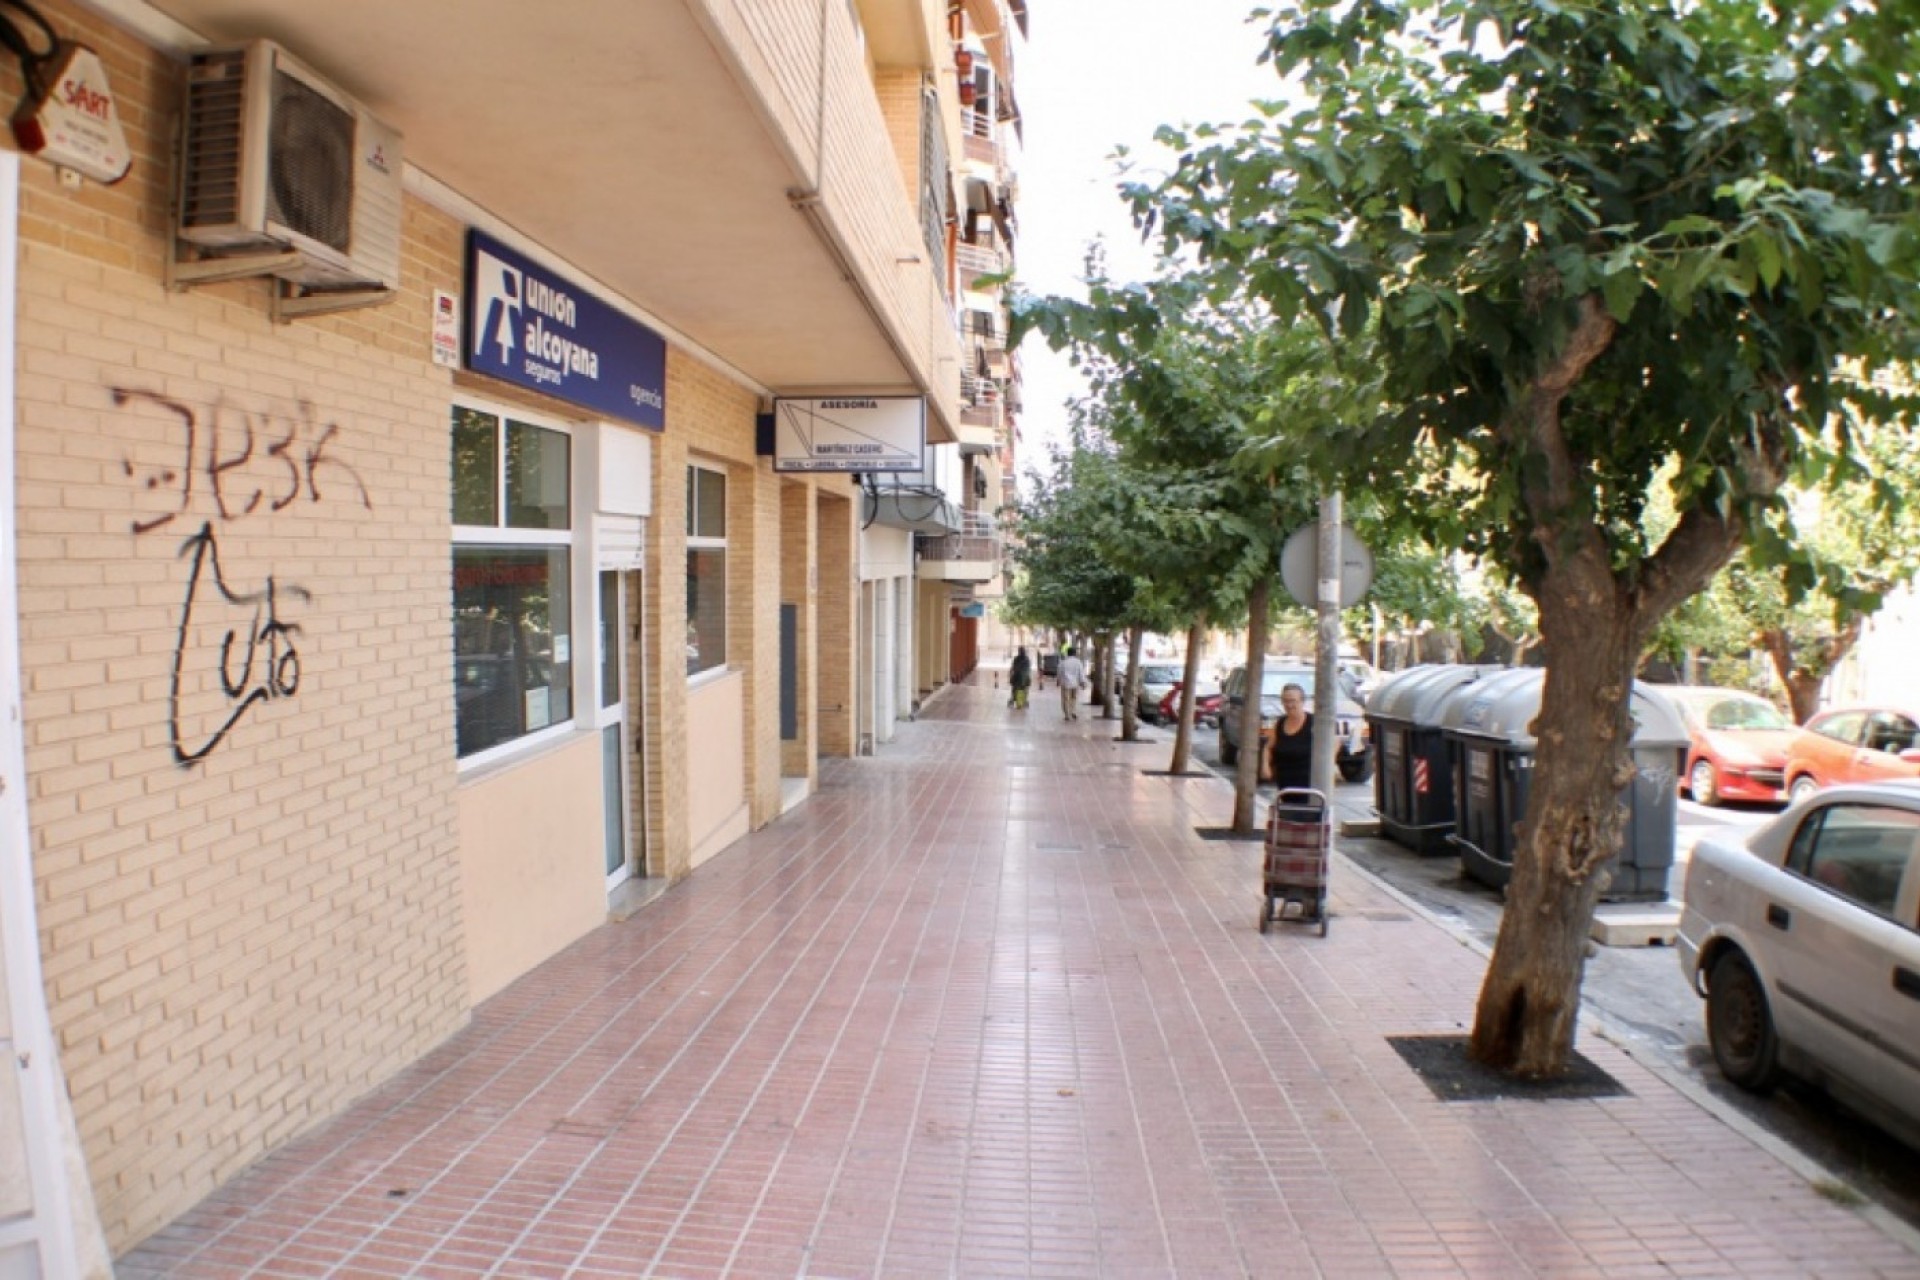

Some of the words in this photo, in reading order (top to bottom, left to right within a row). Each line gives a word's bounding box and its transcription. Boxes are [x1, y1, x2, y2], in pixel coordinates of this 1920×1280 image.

[525, 275, 577, 328] unión
[525, 317, 599, 379] alcoyana
[525, 359, 561, 385] seguros
[630, 384, 662, 409] agencia
